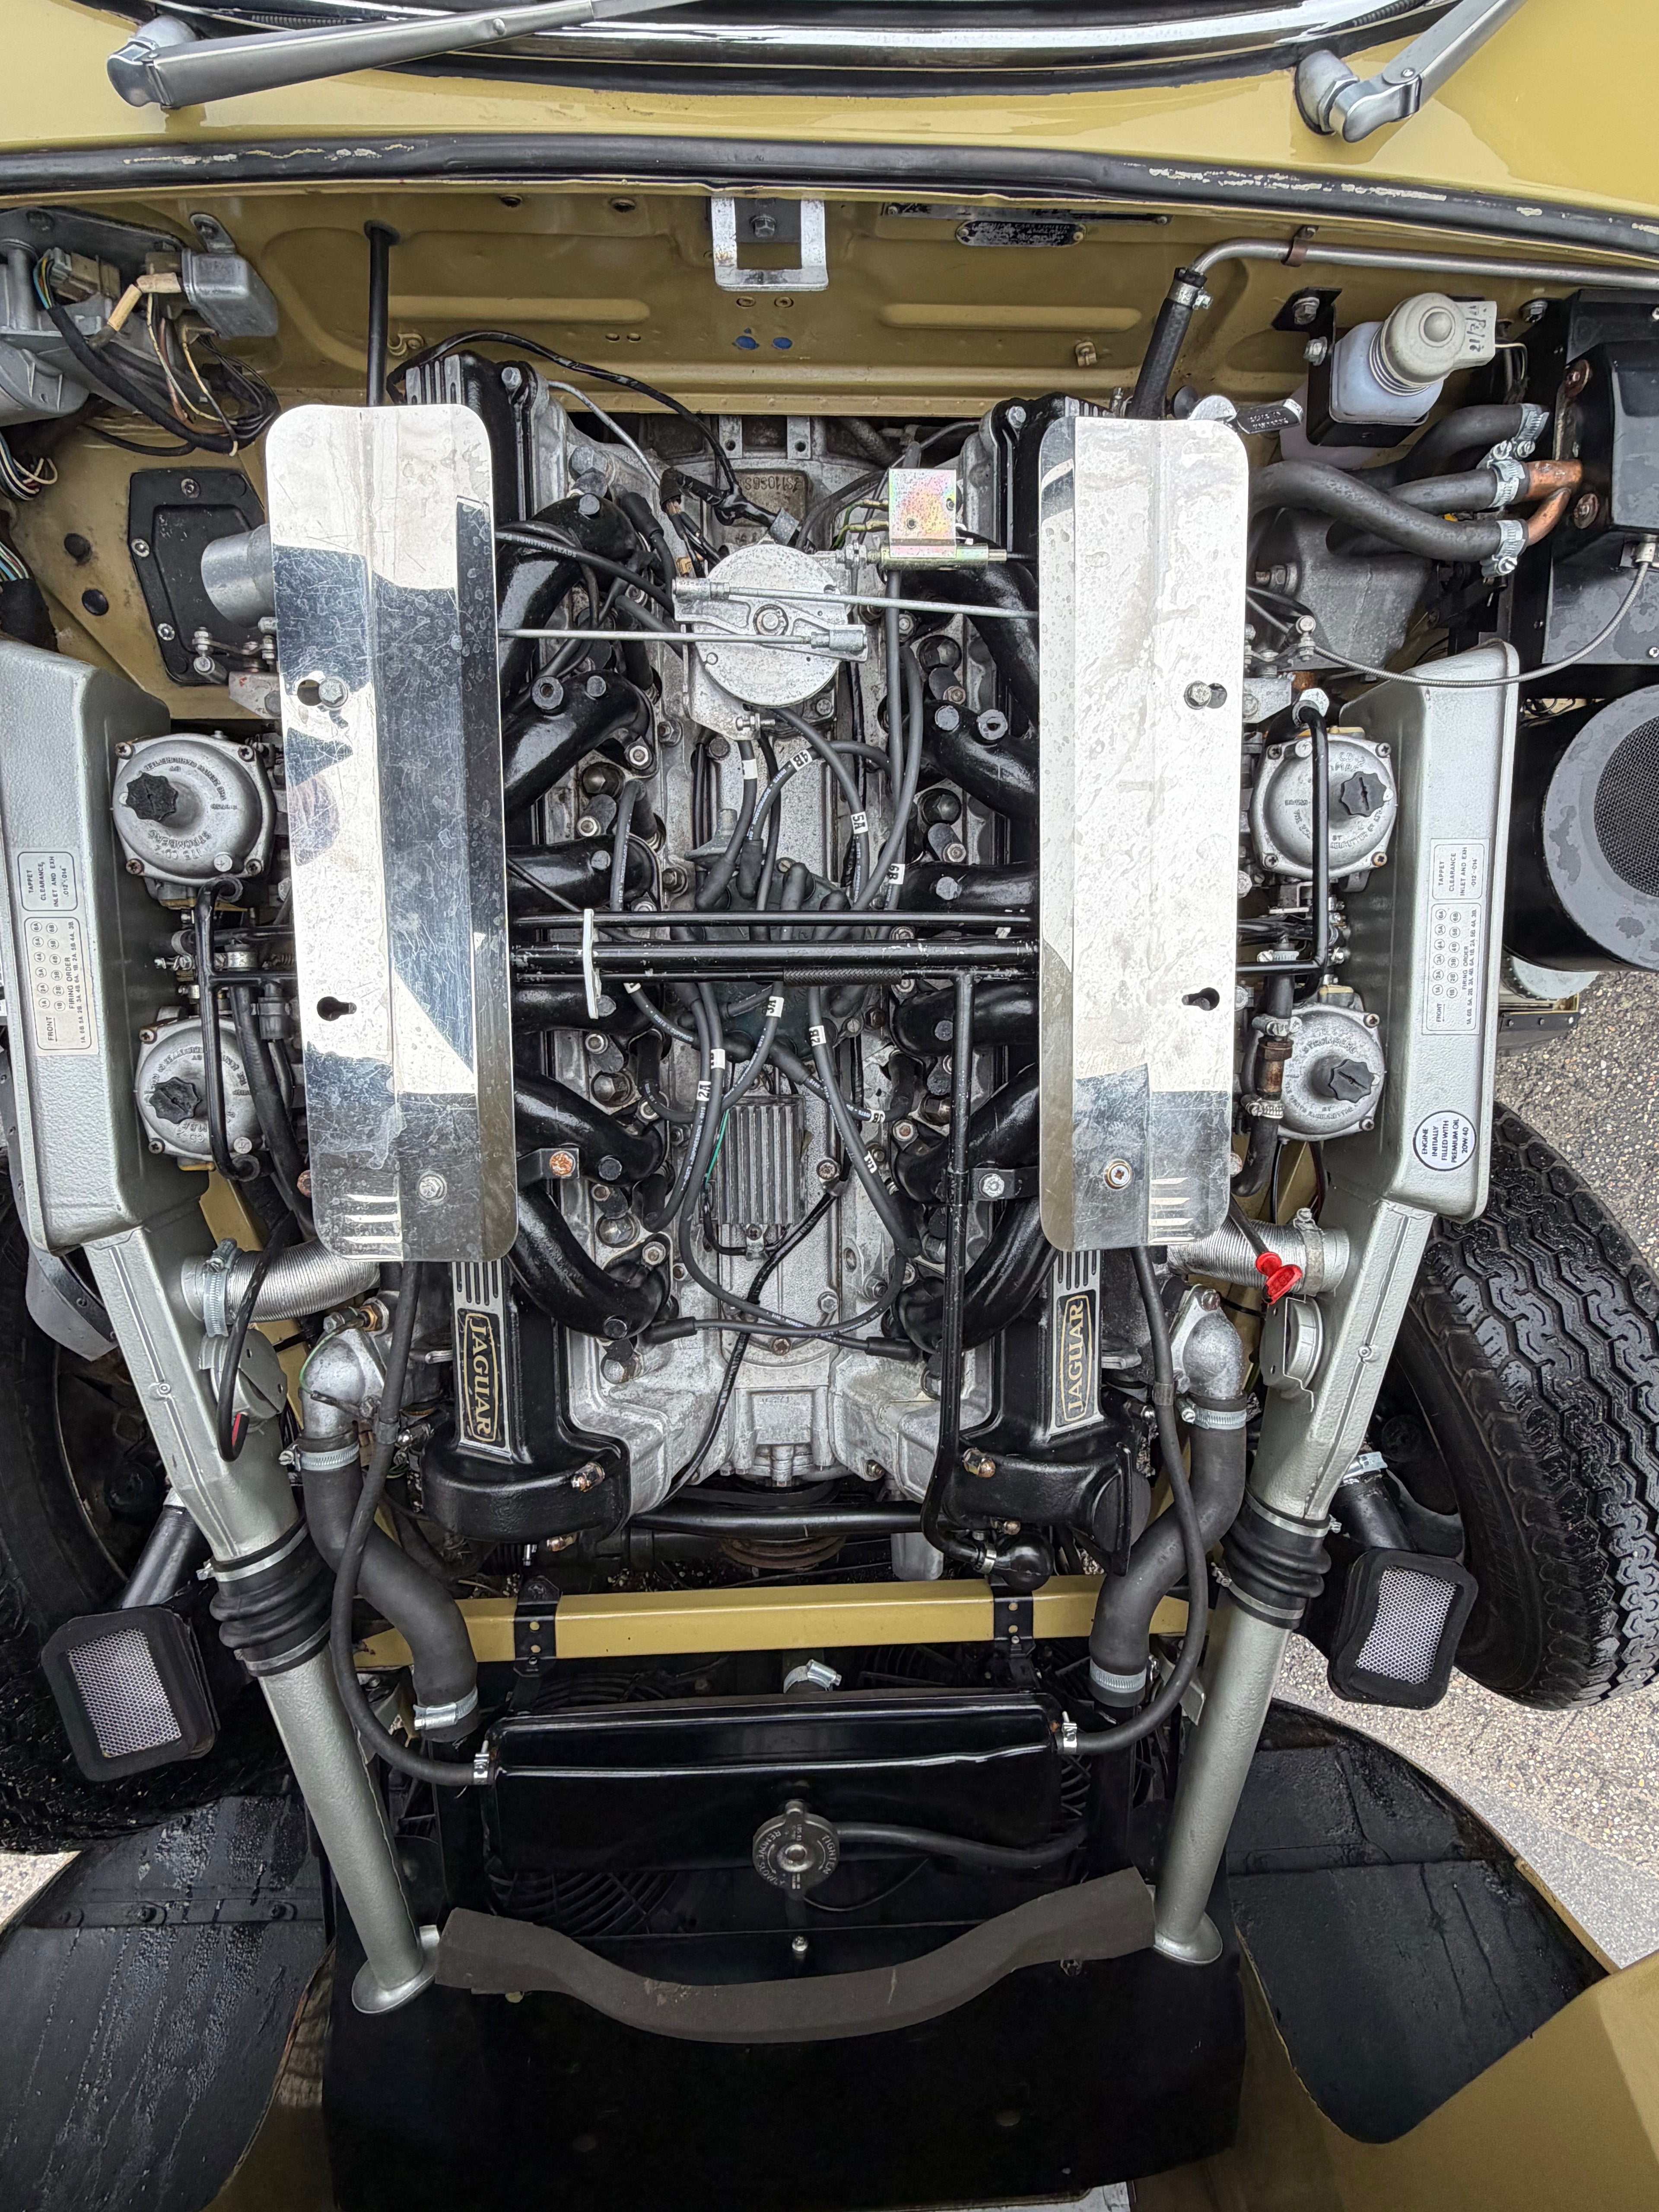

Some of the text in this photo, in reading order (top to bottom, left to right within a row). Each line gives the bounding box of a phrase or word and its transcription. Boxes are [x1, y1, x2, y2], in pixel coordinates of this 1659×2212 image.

[517, 535, 551, 550] IGNITION
[553, 543, 578, 558] LEADS
[793, 752, 808, 767] 4B
[853, 814, 866, 830] 5A
[148, 830, 212, 849] STROMBERG
[887, 865, 899, 880] 6B
[1453, 913, 1458, 921] 6B
[65, 957, 75, 1009] FIRING ORDER
[46, 1017, 54, 1041] FRONT
[1301, 1036, 1357, 1053] STROMBERG
[698, 1084, 710, 1098] 2A
[690, 1125, 702, 1163] SUPPRESSION
[1068, 1300, 1084, 1412] JAGUAR
[469, 1318, 492, 1435] JAGUAR
[757, 1830, 785, 1885] REMOVE SLOWLY
[822, 1834, 837, 1875] TIGHTEN
